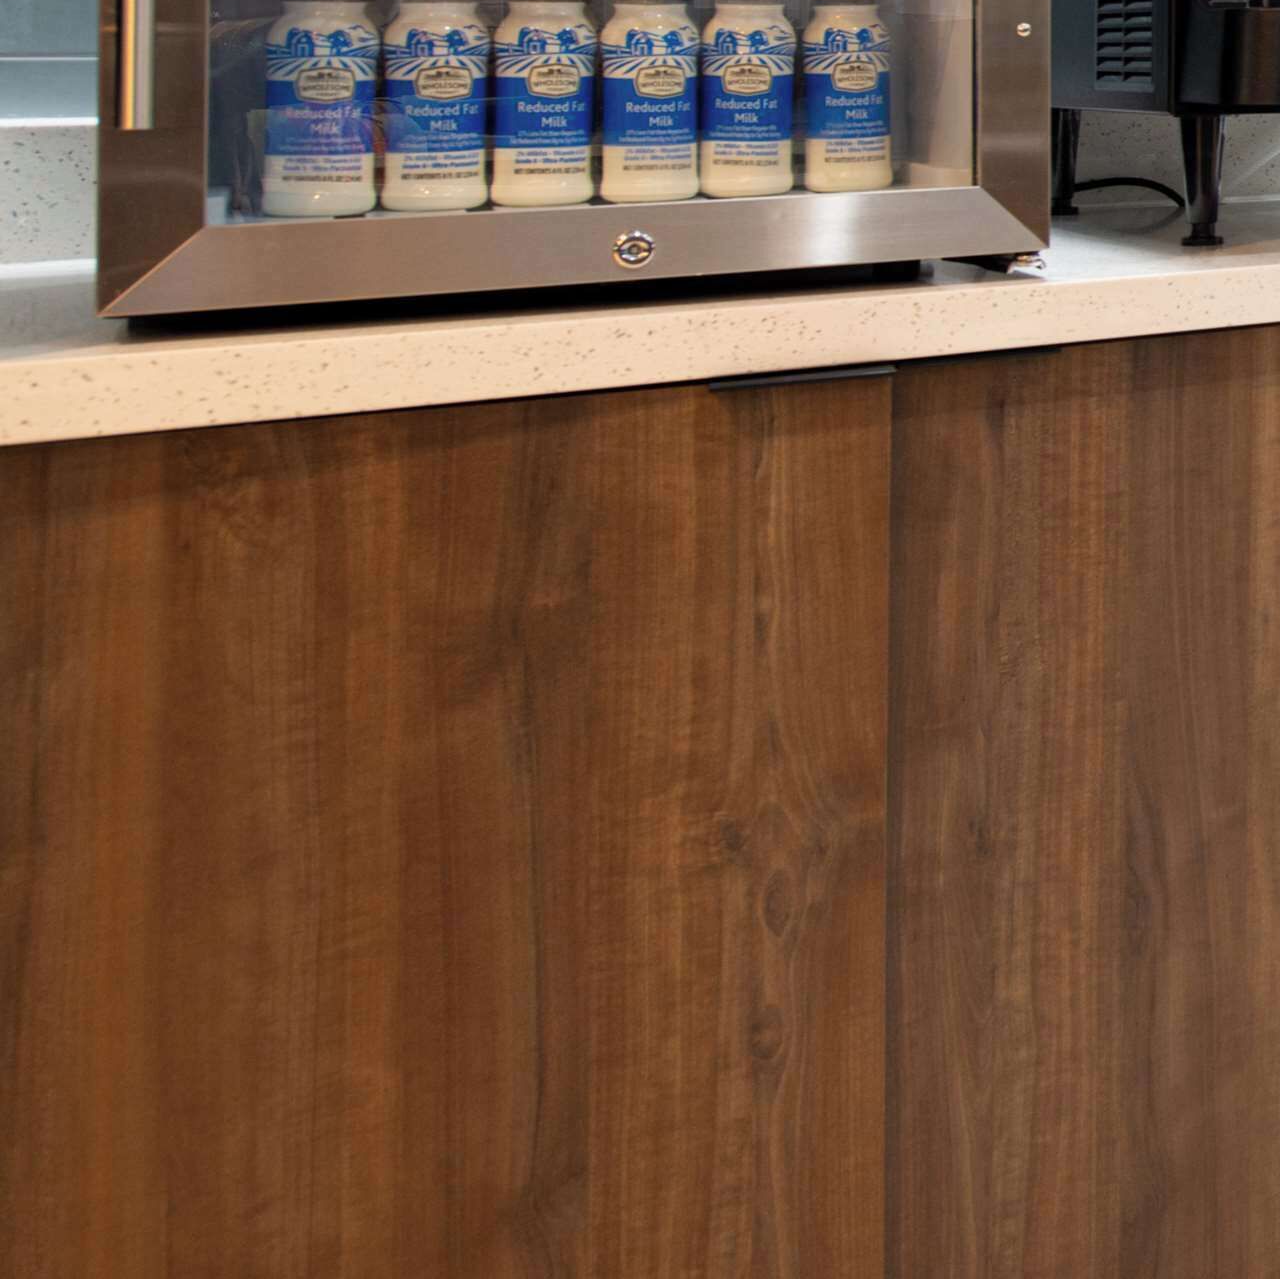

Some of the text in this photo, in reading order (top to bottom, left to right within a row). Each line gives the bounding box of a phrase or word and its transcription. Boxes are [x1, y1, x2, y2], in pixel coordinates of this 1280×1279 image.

[518, 101, 569, 113] Reduced
[626, 101, 675, 113] Reduced
[715, 98, 778, 110] Reduced Fat
[825, 95, 869, 107] Reduced
[405, 104, 460, 117] Reduced
[845, 109, 869, 120] Milk
[541, 116, 567, 128] Milk
[649, 116, 673, 127] Milk
[734, 112, 758, 124] Milk
[430, 119, 458, 131] Milk
